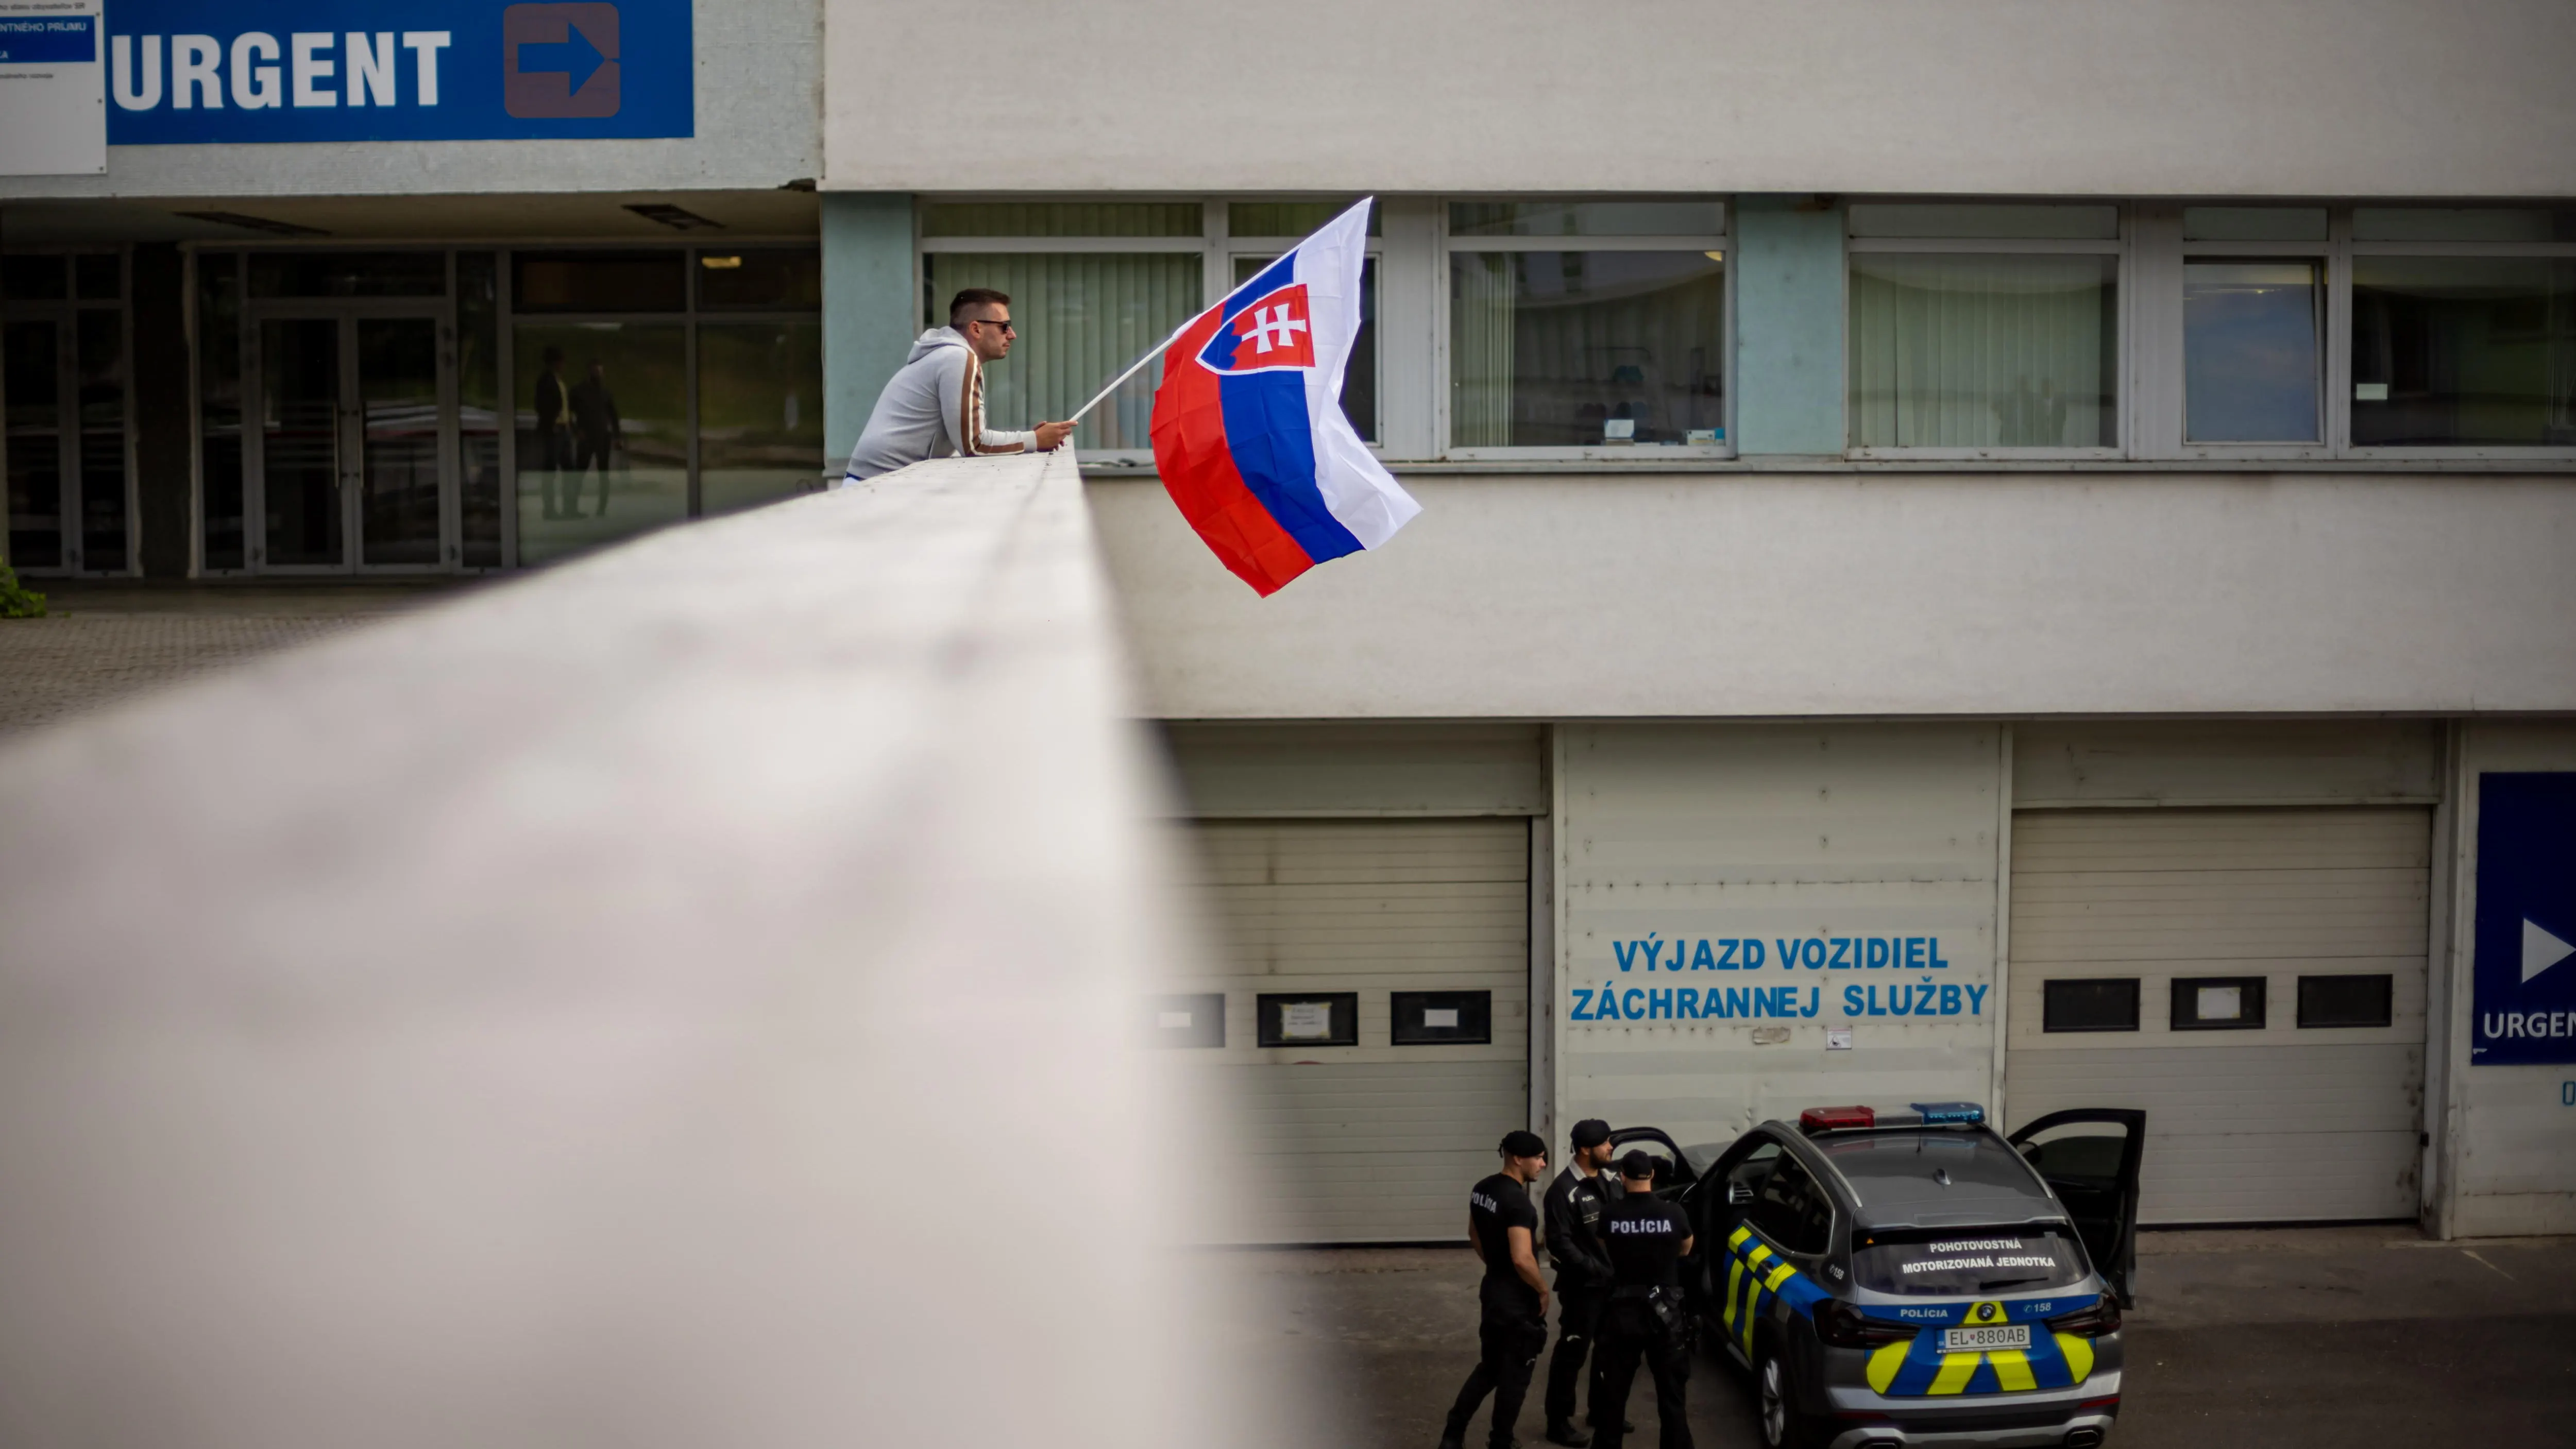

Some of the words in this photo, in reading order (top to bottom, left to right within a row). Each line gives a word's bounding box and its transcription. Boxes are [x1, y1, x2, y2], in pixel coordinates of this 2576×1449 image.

[111, 31, 451, 111] URGENT
[1613, 932, 1766, 972] VÝJAZD
[1777, 937, 1948, 970] VOZIDIEL
[1571, 981, 1820, 1020] ZÁCHRANNEJ
[1843, 976, 1989, 1016] SLUŽBY
[1611, 1219, 1672, 1234] POLÍCIA
[1929, 1237, 2022, 1253] POHOTOVOSTNÁ
[1902, 1256, 1994, 1274] MOTORIZOVANÁ
[1996, 1257, 2056, 1267] JEDNOTKA
[1834, 1267, 1844, 1280] 158
[1900, 1308, 1948, 1318] POLÍCIA
[2034, 1302, 2051, 1312] 158
